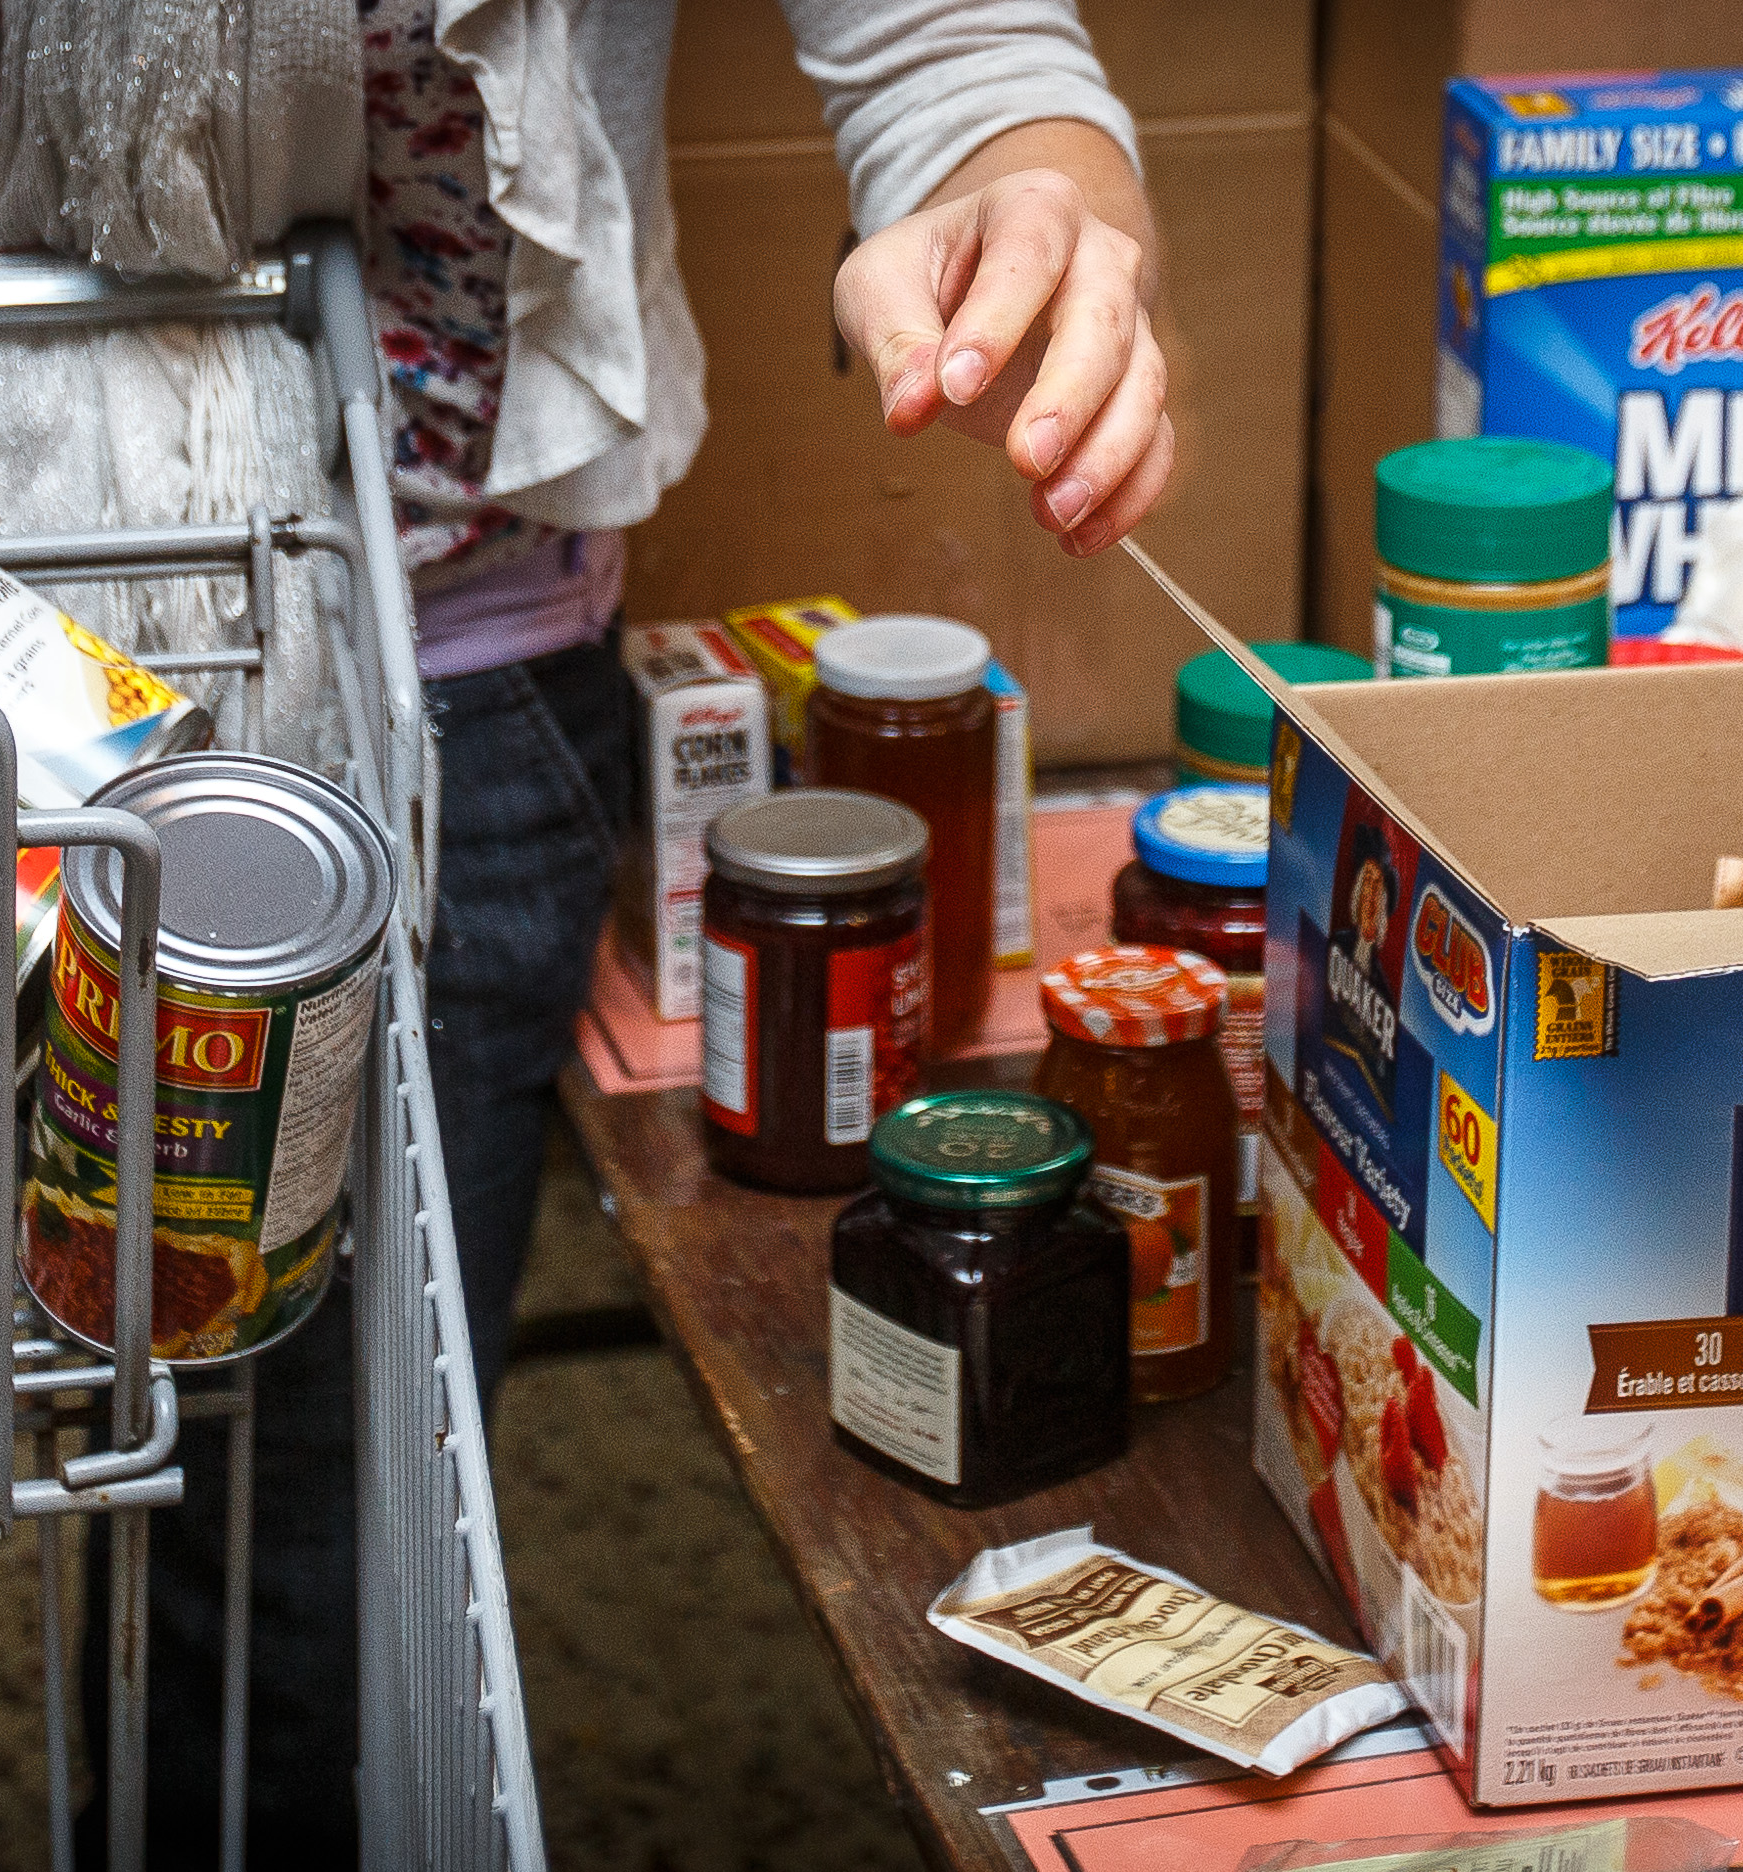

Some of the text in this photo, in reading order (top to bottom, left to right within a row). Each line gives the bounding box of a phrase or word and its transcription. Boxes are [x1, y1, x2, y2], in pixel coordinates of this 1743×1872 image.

[1498, 129, 1624, 174] FAMILY
[1630, 125, 1702, 170] SIZE
[154, 1113, 232, 1140] ESTY
[1445, 1093, 1481, 1166] 60
[155, 1141, 189, 1159] erb
[1694, 1332, 1723, 1368] 30
[1616, 1364, 1675, 1400] Érable
[1677, 1371, 1697, 1394] et
